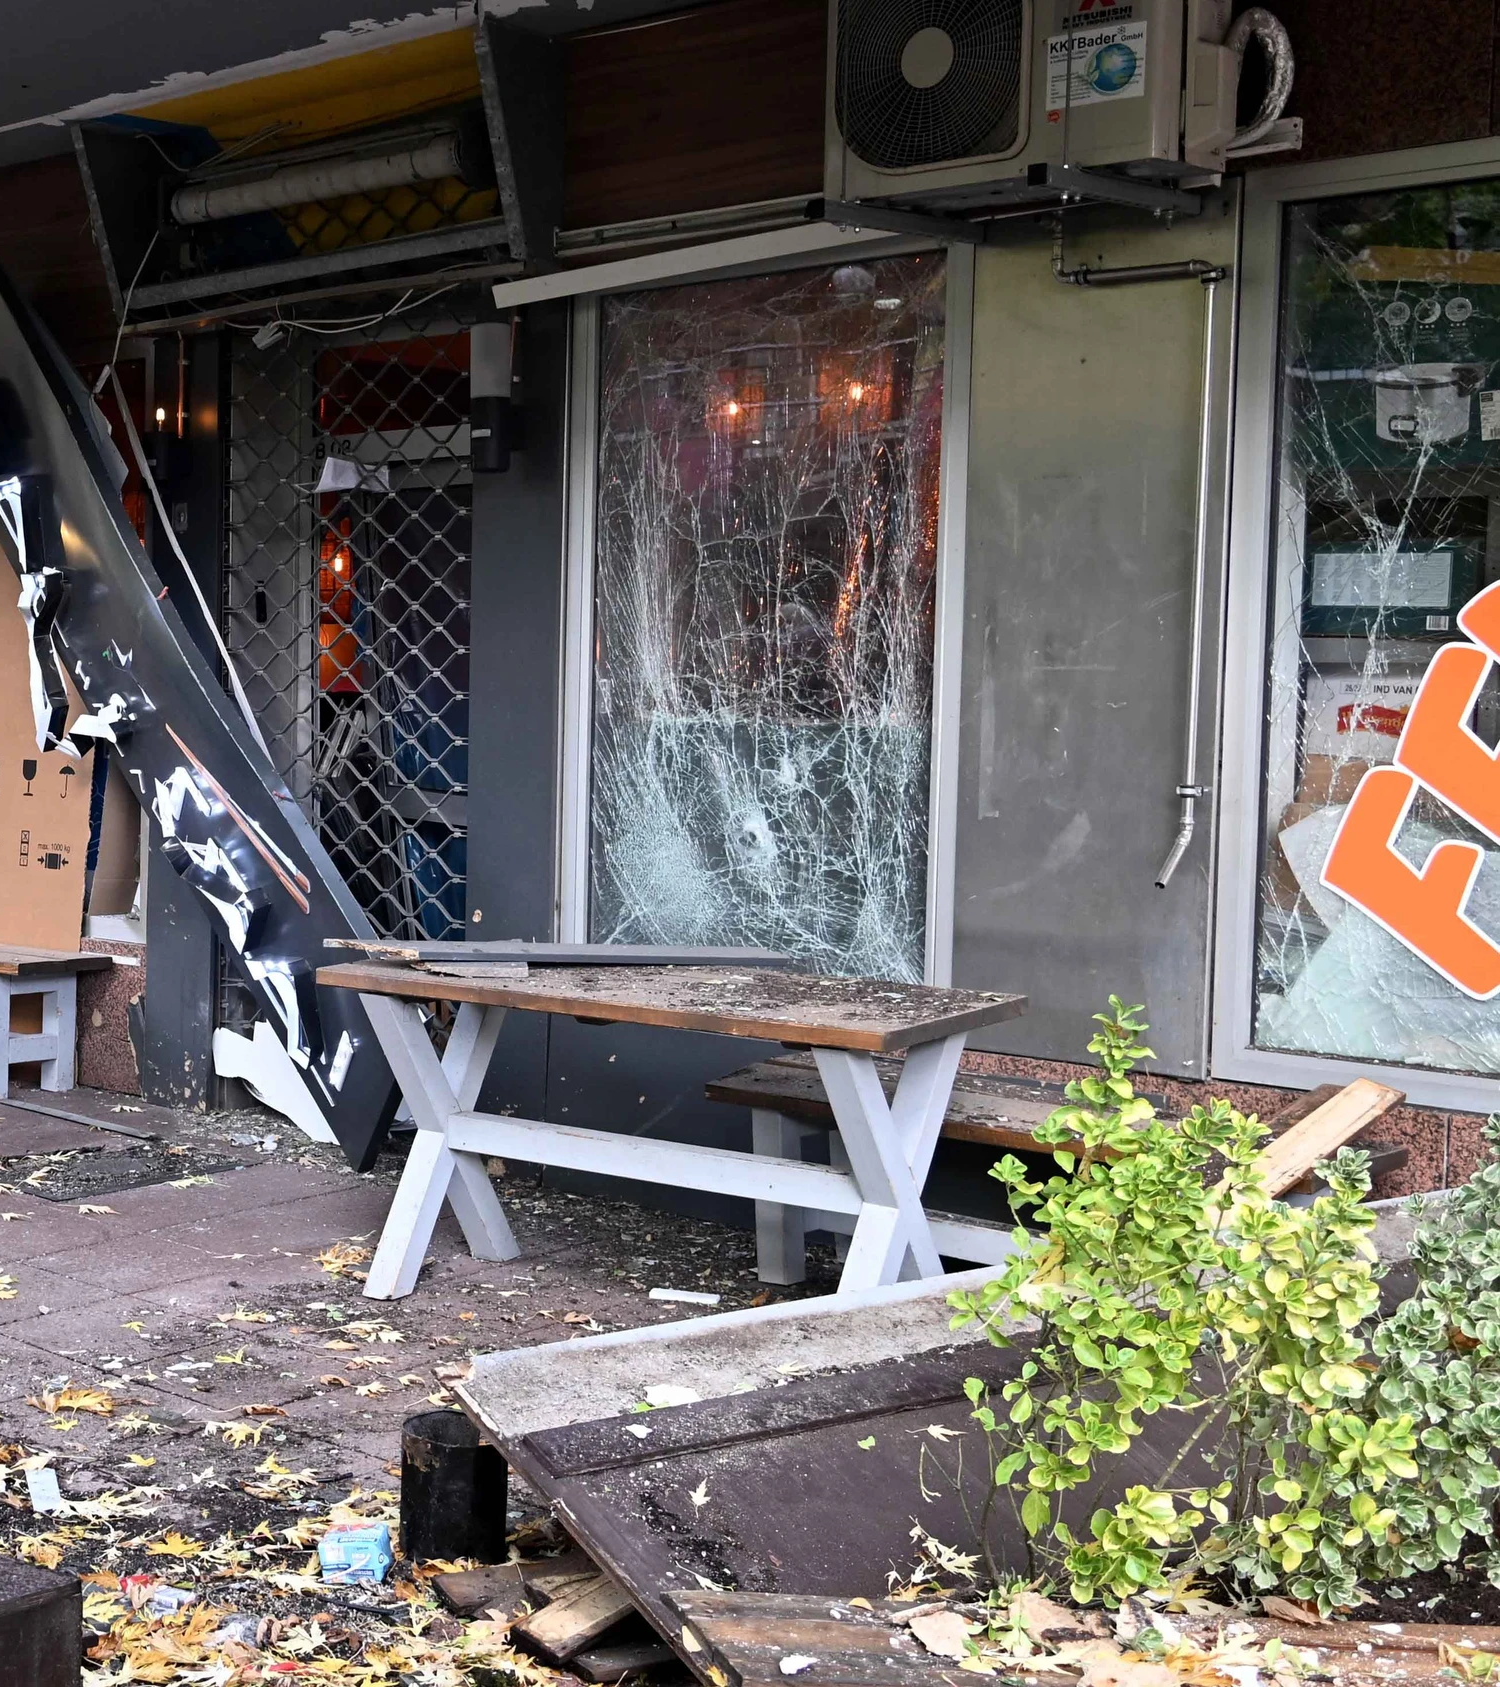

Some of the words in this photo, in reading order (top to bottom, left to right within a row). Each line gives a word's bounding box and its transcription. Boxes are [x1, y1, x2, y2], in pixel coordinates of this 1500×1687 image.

[1049, 33, 1117, 54] KKTBader
[1120, 32, 1144, 42] GmbH
[51, 842, 63, 851] 1000
[64, 844, 71, 854] kg
